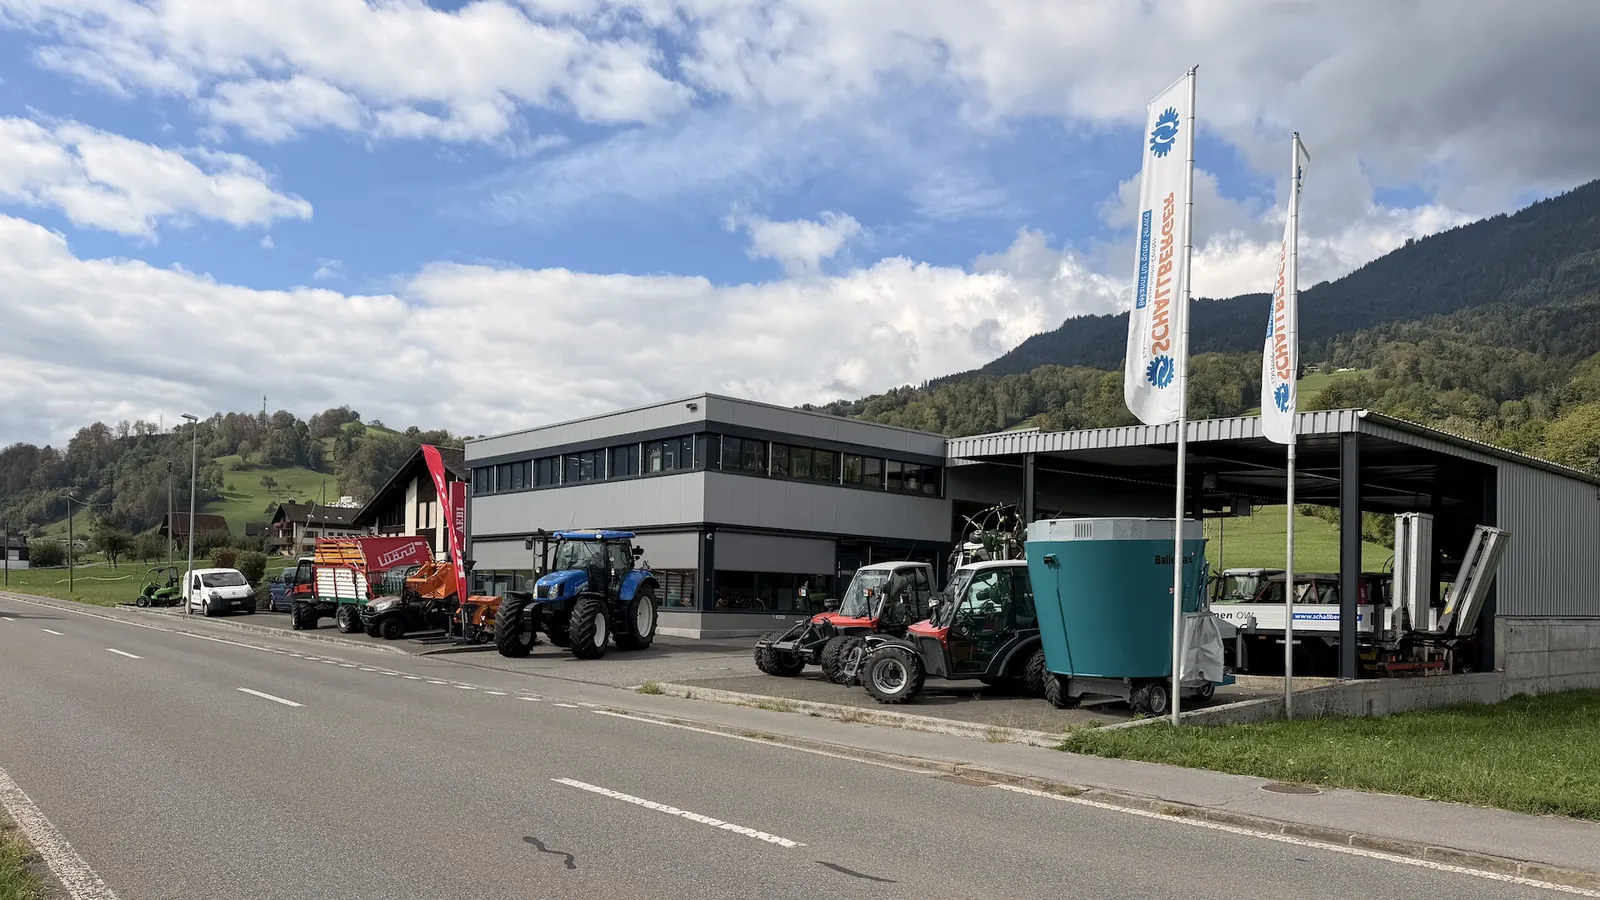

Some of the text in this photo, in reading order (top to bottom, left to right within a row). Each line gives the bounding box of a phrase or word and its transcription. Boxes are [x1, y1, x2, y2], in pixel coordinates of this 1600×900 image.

[456, 507, 464, 533] AEBI
[1155, 555, 1193, 565] Balleax
[1294, 613, 1360, 621] www.schallber
